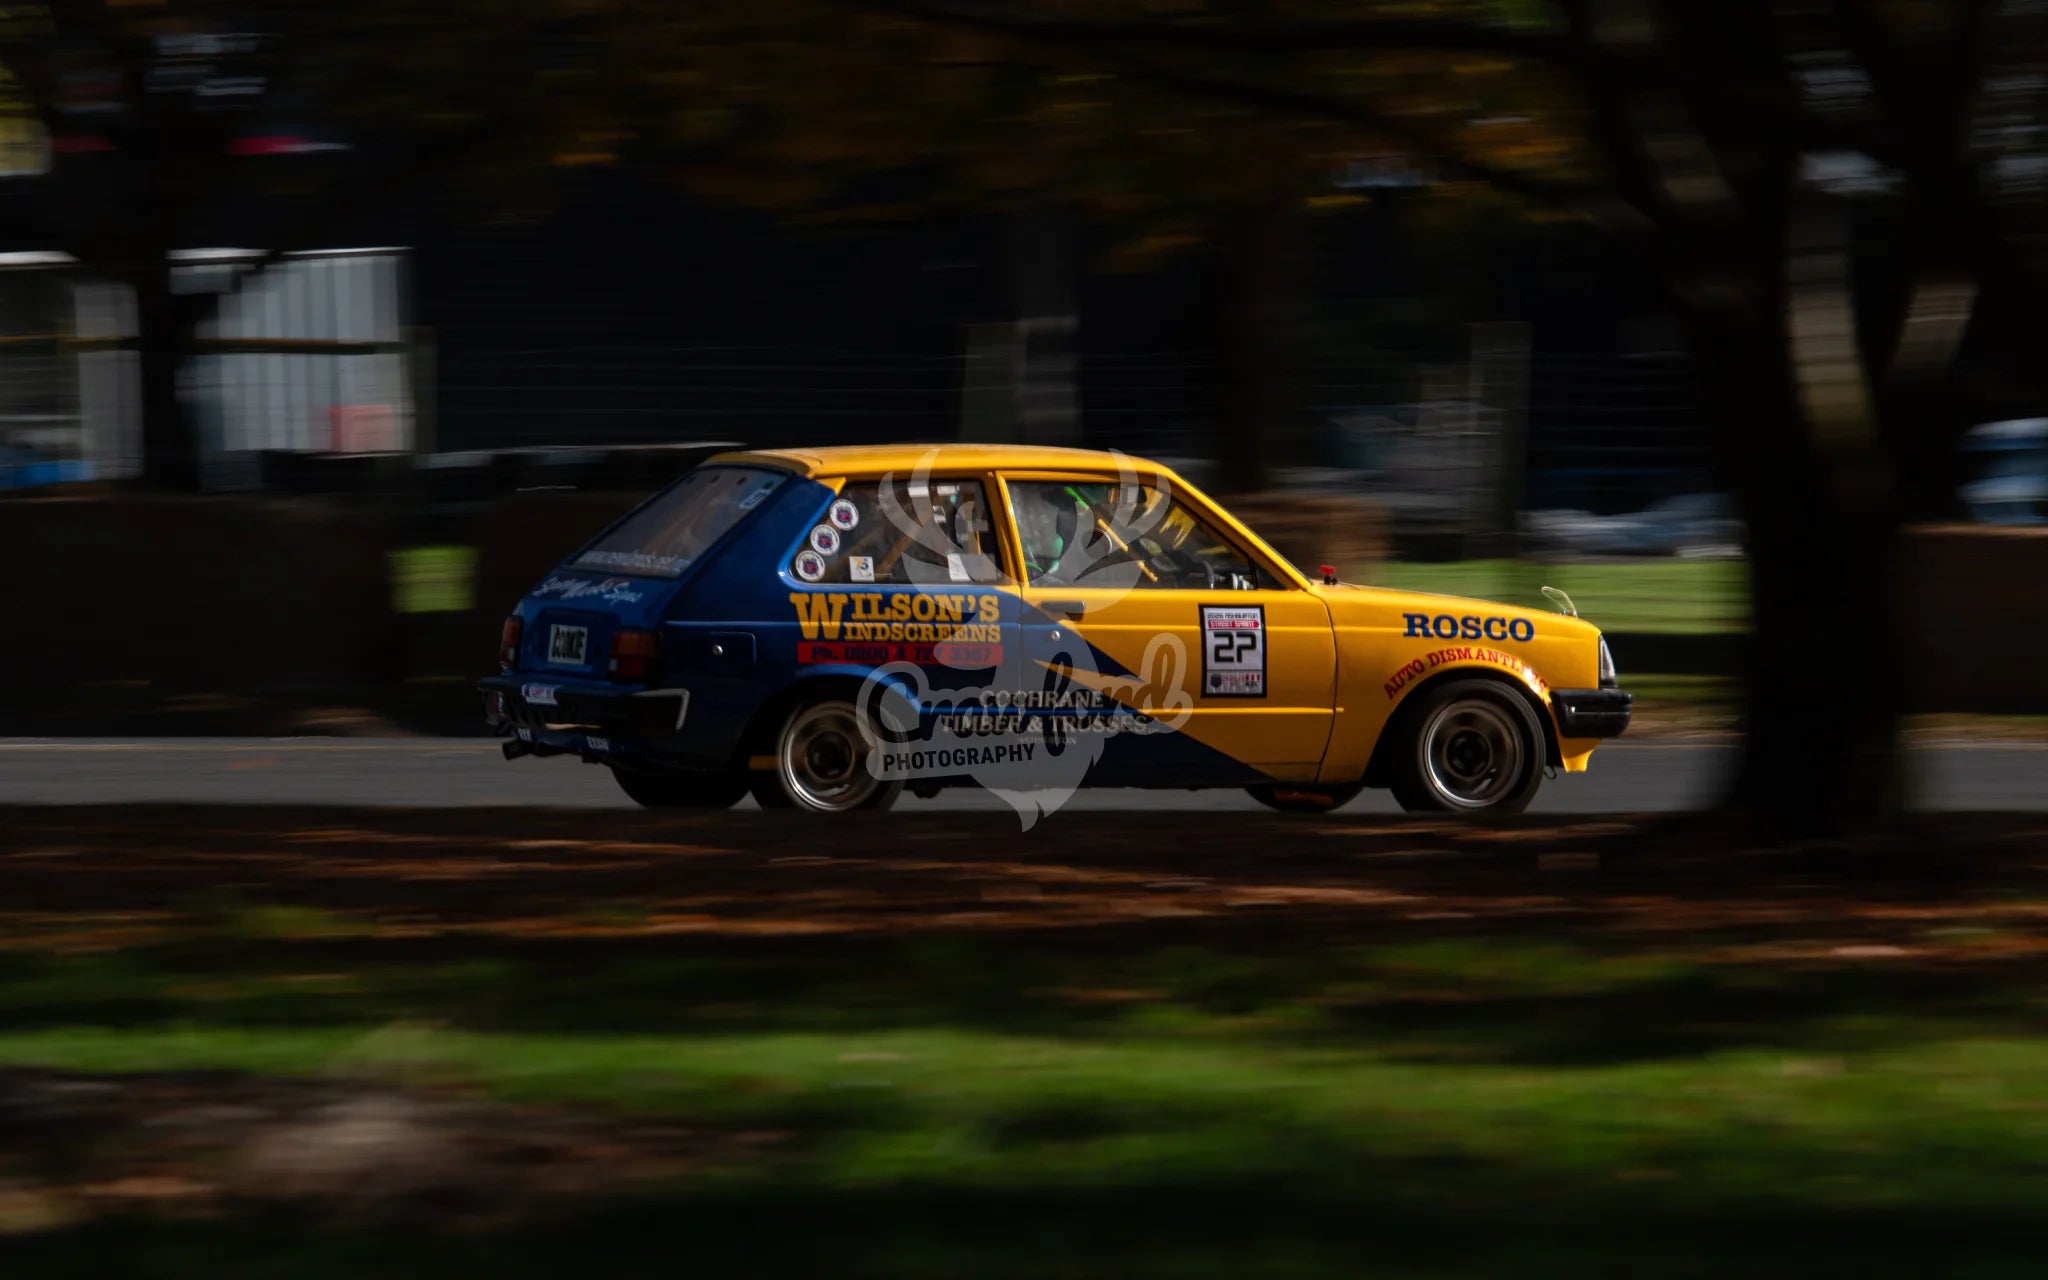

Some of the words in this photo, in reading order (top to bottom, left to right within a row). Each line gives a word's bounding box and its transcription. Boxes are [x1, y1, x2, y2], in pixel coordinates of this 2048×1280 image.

[789, 592, 1000, 640] WILSON'S
[1403, 613, 1535, 642] ROSCO
[1384, 658, 1425, 699] AUTO
[978, 690, 1104, 709] COCHRANE
[941, 714, 1023, 733] TIMBER
[1027, 714, 1044, 733] &
[1049, 714, 1148, 734] TRUSSES
